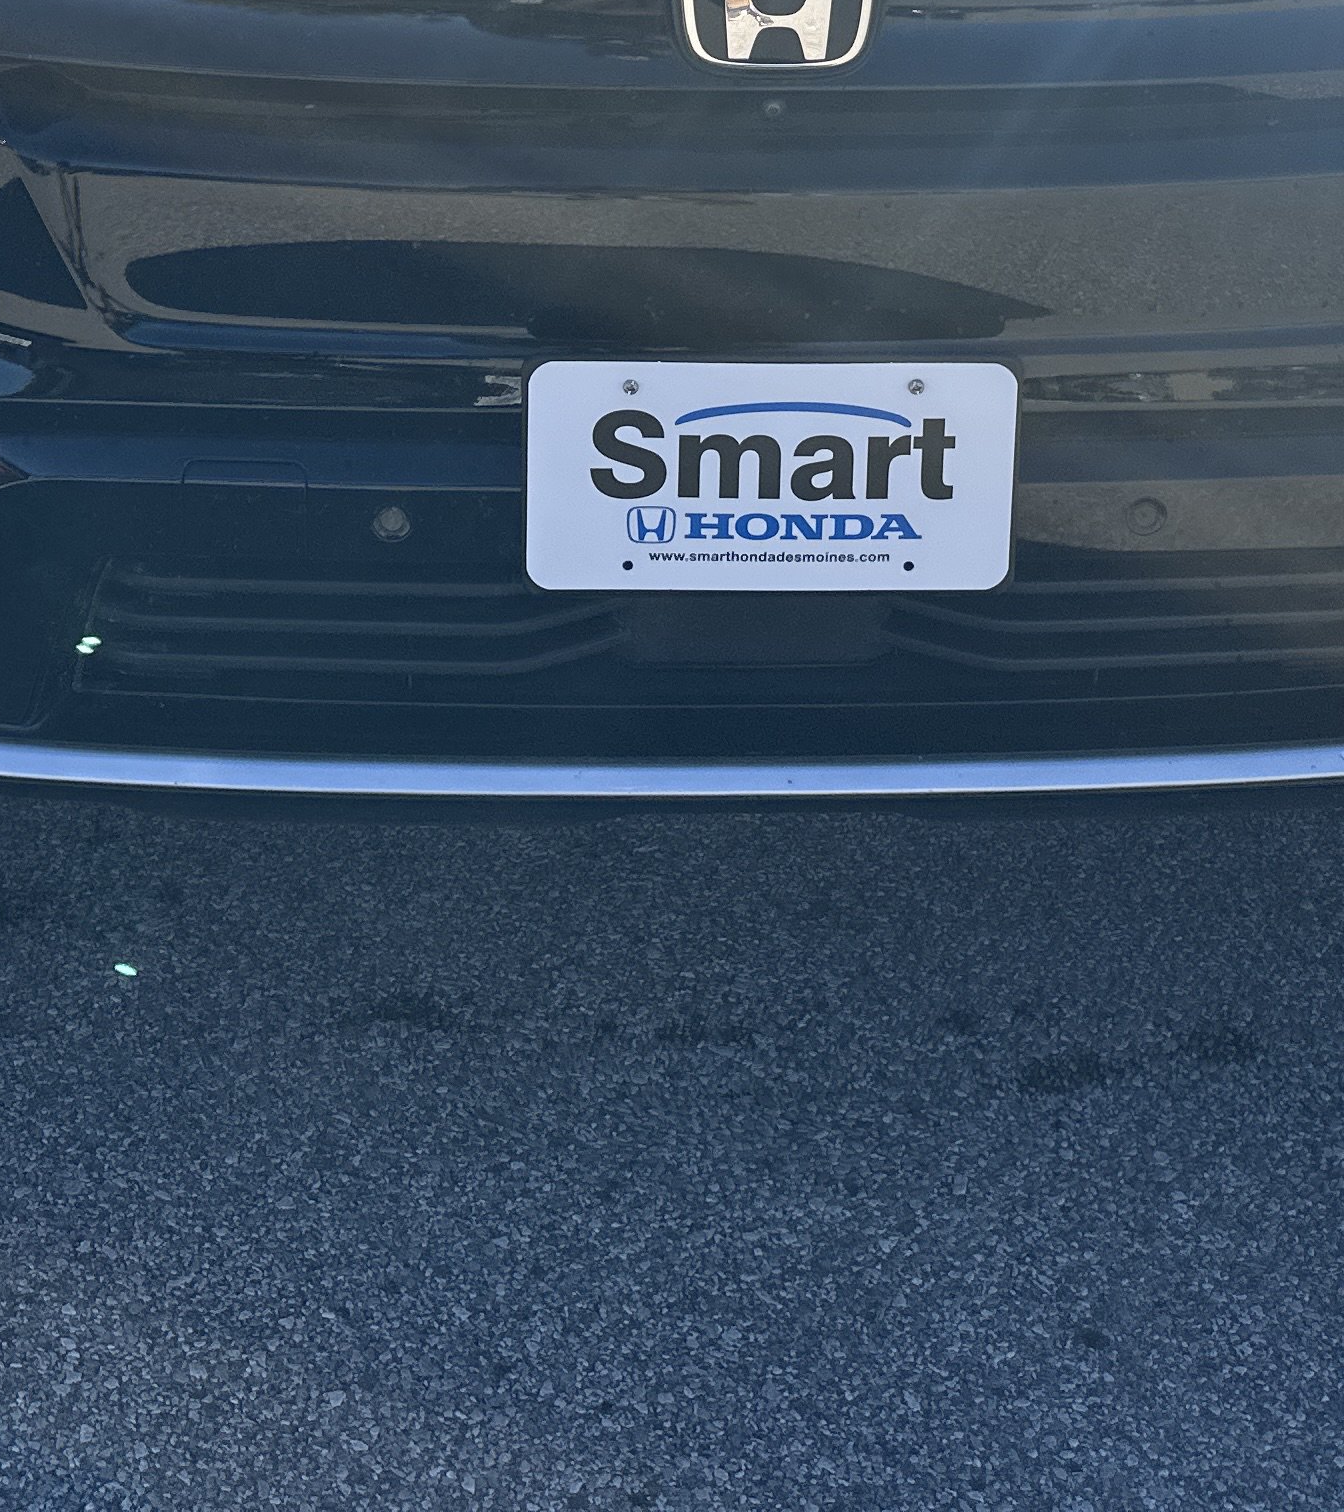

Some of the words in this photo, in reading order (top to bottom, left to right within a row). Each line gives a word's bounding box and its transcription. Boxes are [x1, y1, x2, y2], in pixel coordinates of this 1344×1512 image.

[589, 409, 957, 502] Smart
[684, 512, 923, 541] HONDA
[649, 550, 890, 563] www.smarthondadesmoines.com
